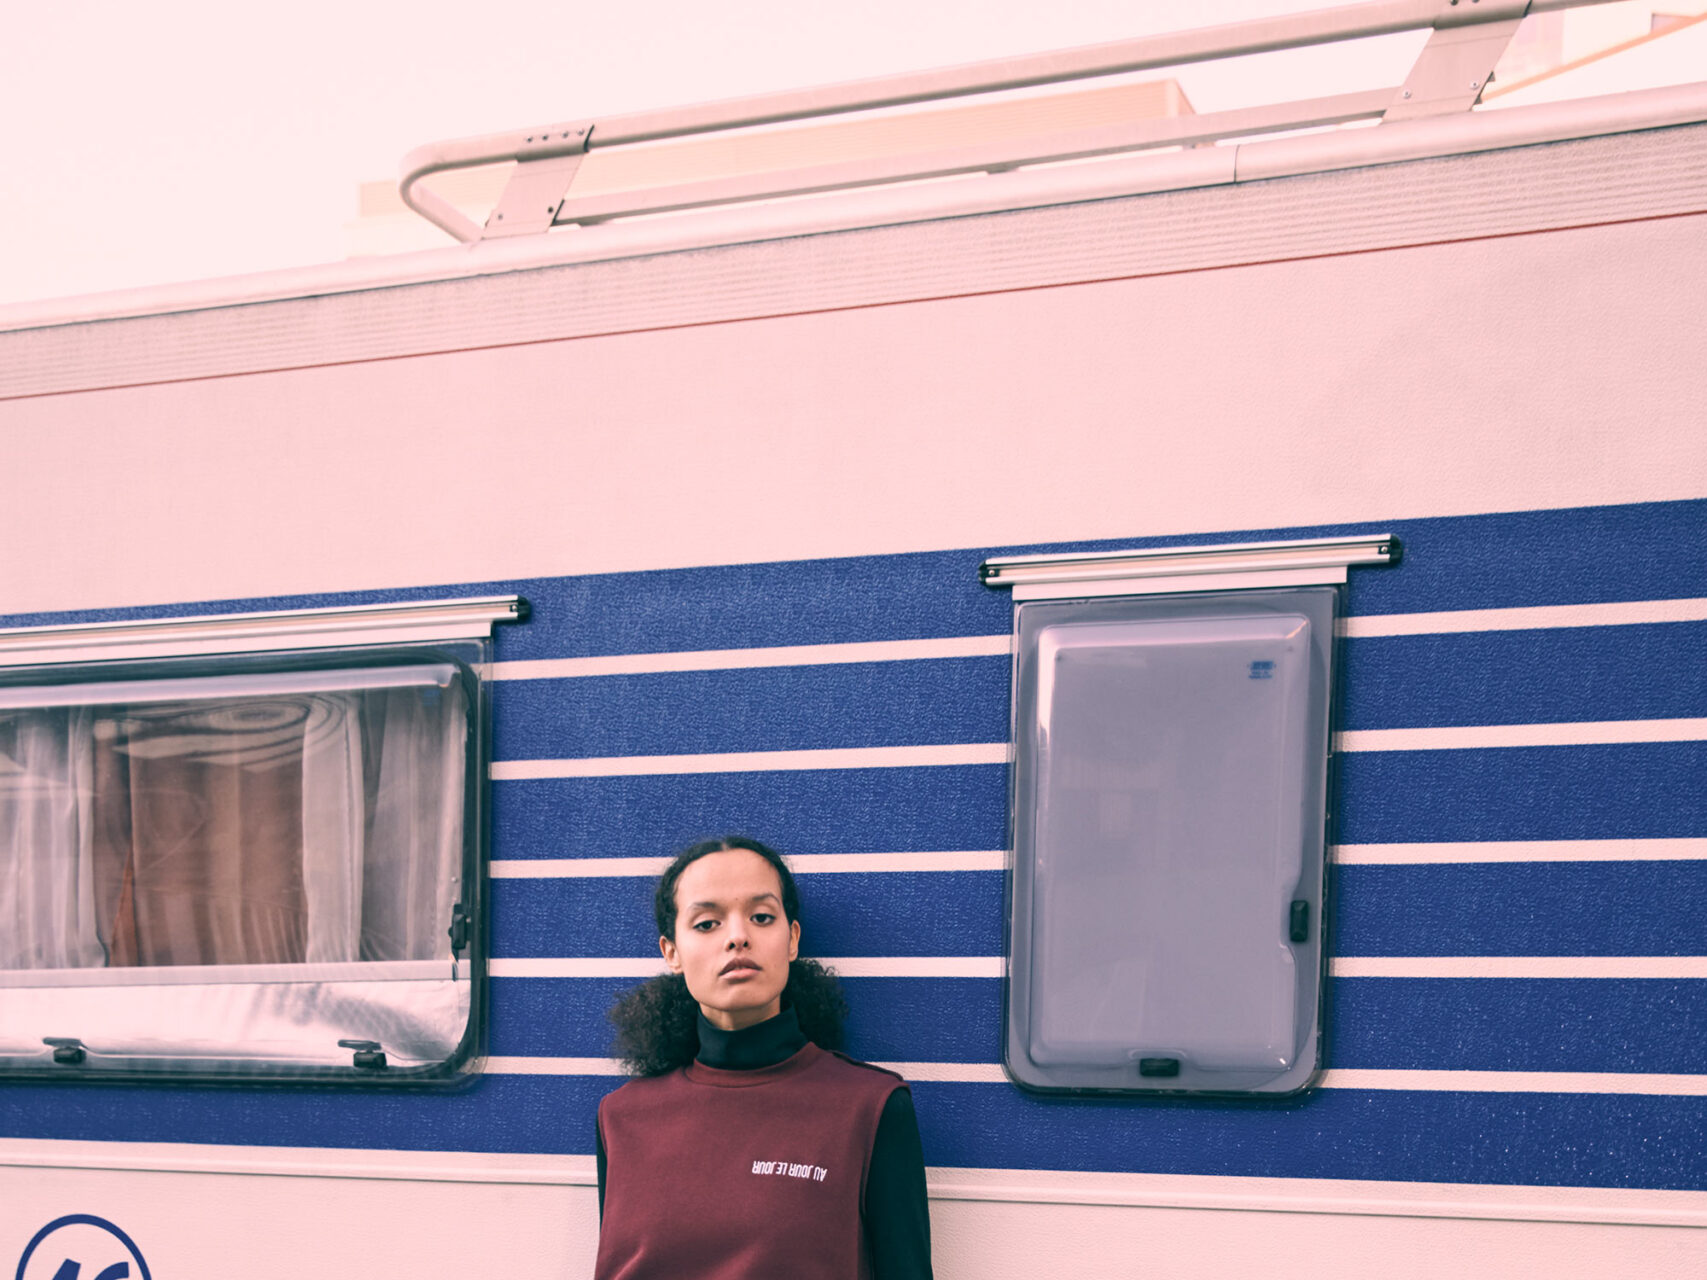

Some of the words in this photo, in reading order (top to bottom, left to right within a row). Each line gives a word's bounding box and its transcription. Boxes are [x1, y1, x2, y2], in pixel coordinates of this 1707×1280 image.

[752, 1160, 777, 1175] JOUR
[775, 1161, 788, 1176] LE
[788, 1163, 814, 1179] JOUR
[813, 1165, 828, 1182] AU
